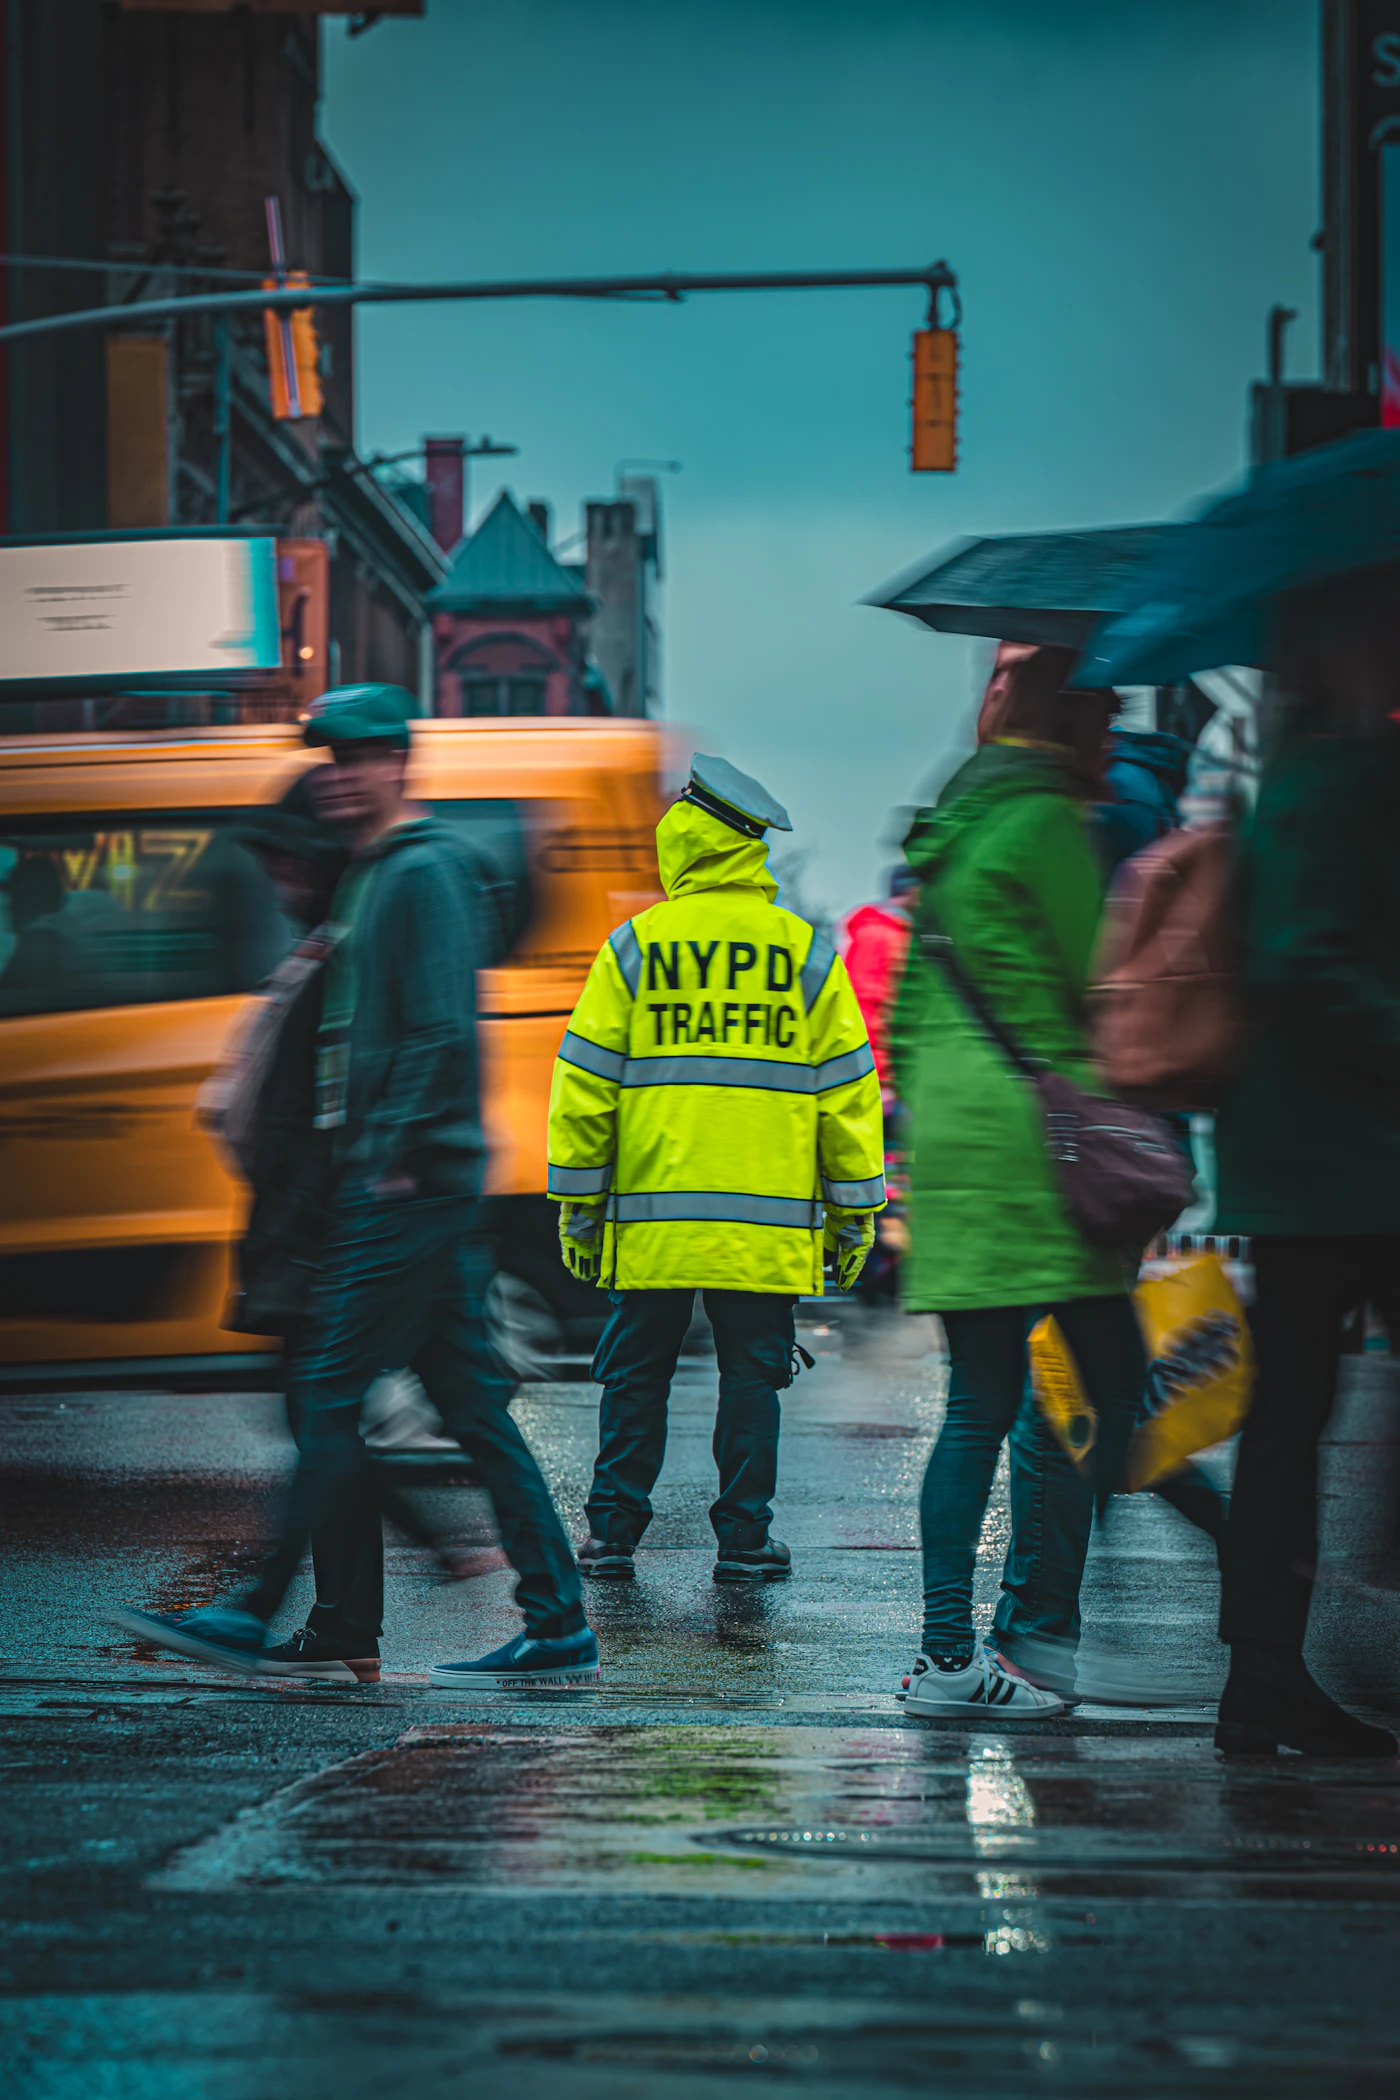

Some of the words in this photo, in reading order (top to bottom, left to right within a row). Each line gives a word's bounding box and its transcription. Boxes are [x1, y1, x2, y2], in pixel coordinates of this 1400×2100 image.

[648, 940, 793, 992] NYPD
[647, 1001, 797, 1048] TRAFFIC
[540, 1676, 562, 1685] WALL
